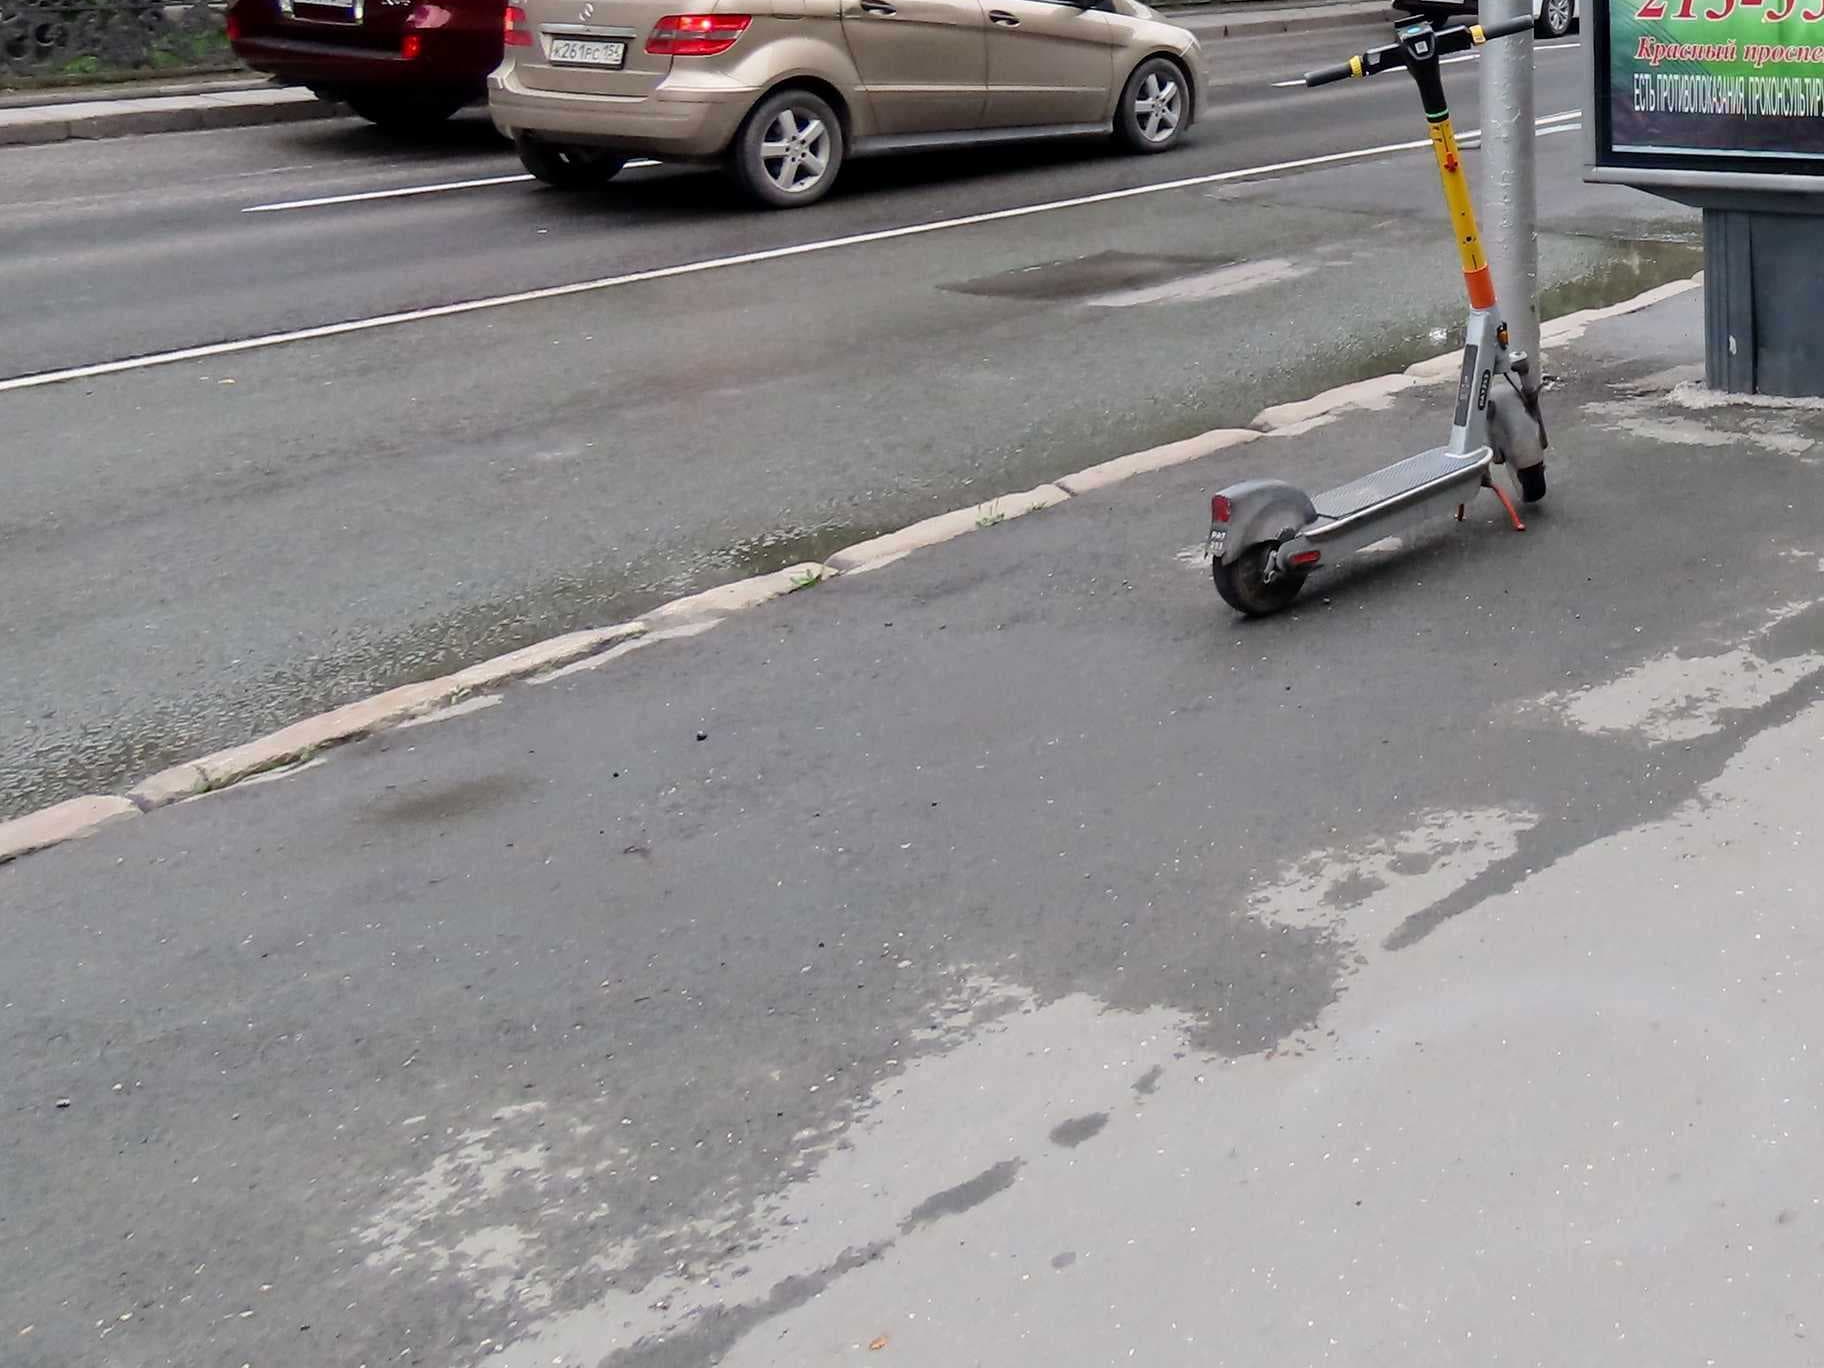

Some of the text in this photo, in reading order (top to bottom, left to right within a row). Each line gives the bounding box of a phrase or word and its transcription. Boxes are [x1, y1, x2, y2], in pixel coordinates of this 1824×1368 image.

[1634, 36, 1737, 68] Красный
[1633, 73, 1655, 112] ЕСТЬ
[1656, 74, 1747, 120] ПРОТИВОПОКАЗАНИЯ,
